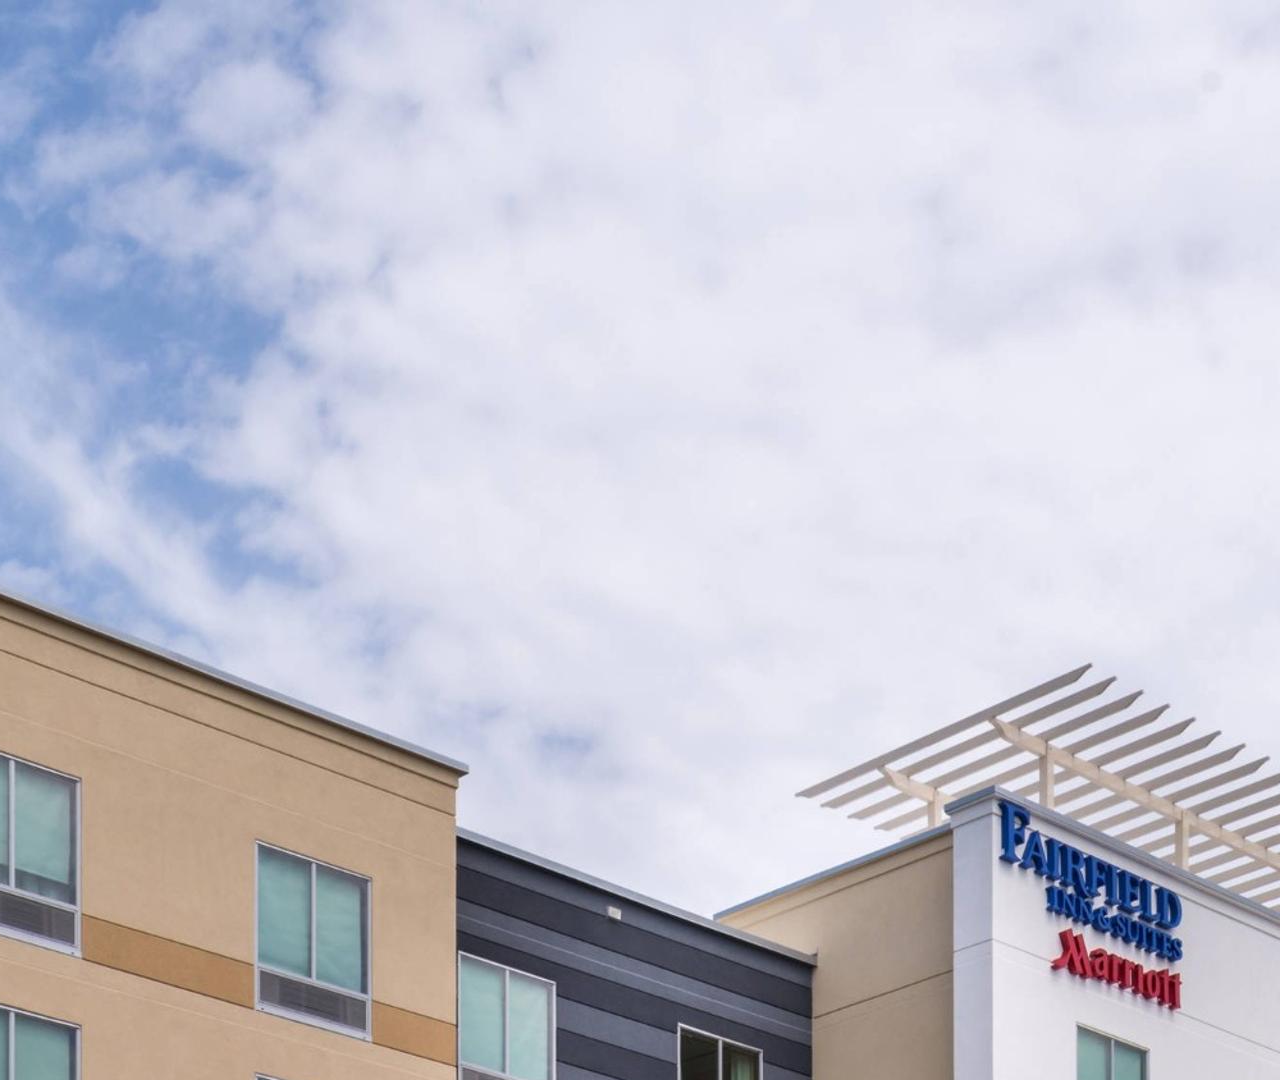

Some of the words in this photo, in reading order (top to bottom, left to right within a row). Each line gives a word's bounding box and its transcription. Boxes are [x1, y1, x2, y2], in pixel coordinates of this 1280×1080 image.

[999, 800, 1183, 930] FAIRFIELD
[1045, 885, 1094, 926] INN
[1091, 906, 1111, 933] &
[1110, 913, 1183, 963] SUITES
[1050, 928, 1183, 1011] Marriott
